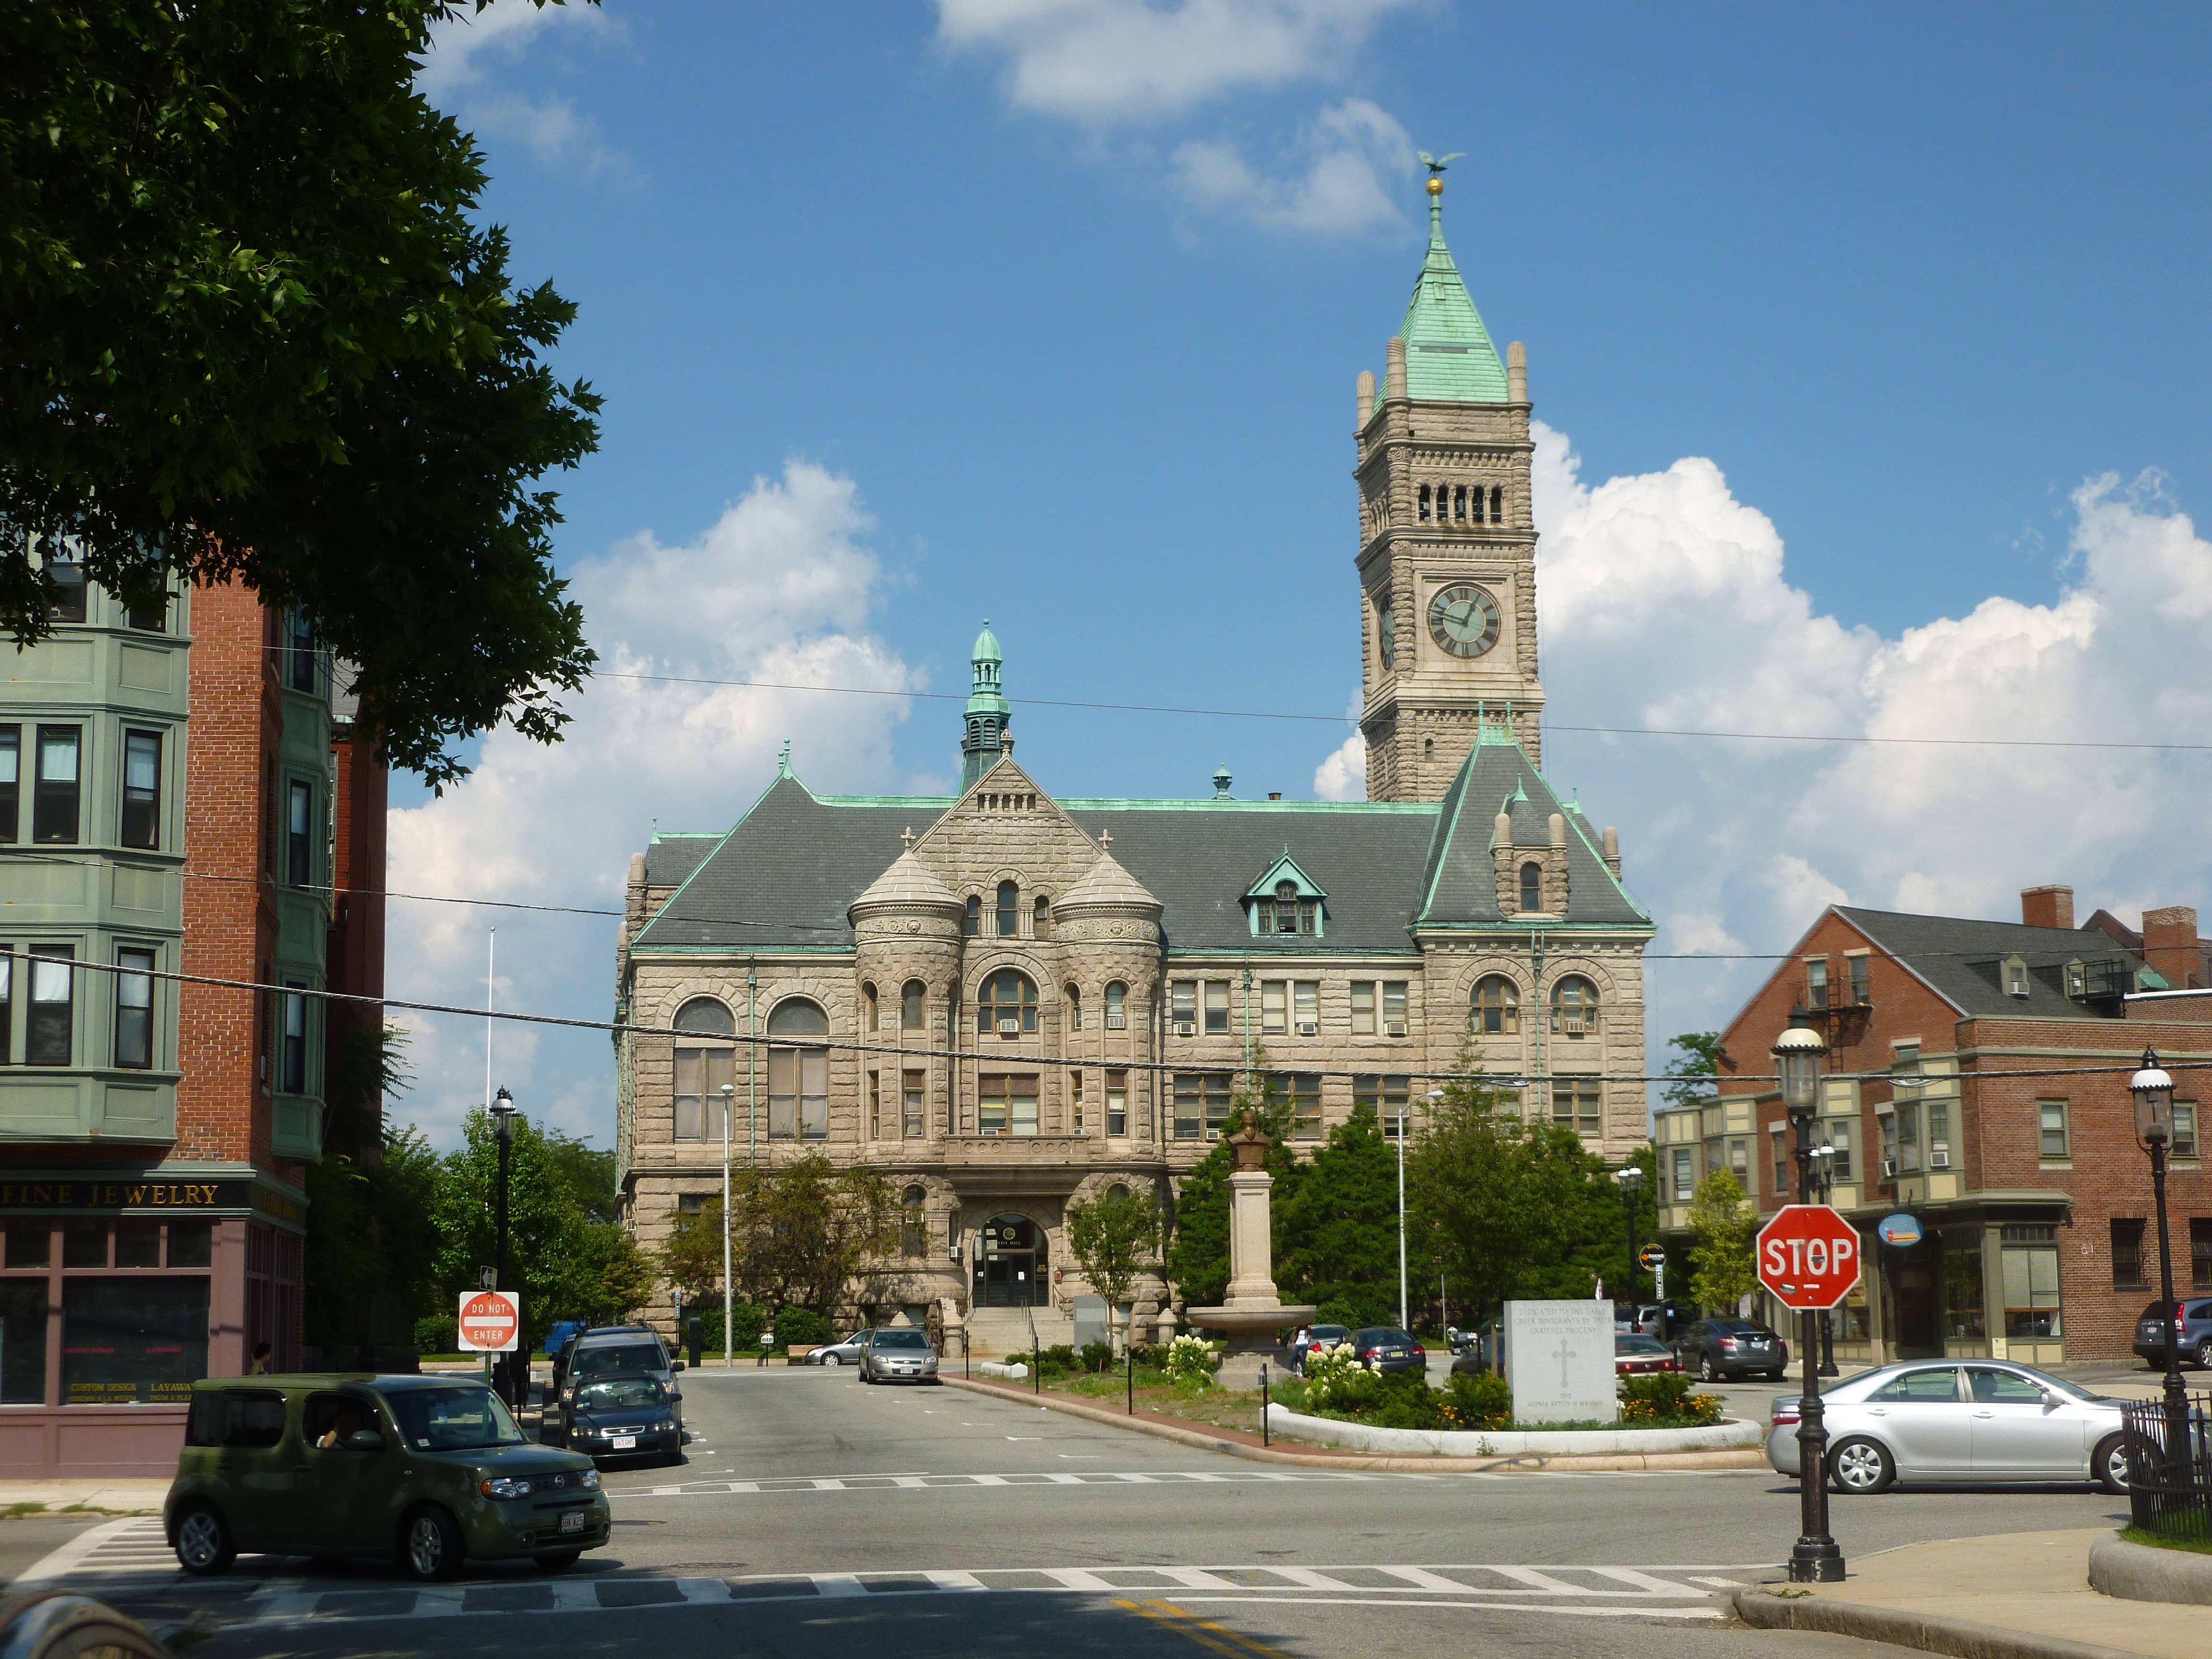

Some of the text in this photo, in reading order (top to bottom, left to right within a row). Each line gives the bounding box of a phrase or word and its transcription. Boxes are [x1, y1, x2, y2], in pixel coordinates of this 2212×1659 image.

[1, 1185, 219, 1207] FINE JEWELRY
[1765, 1238, 1853, 1276] STOP
[472, 1304, 506, 1313] DO NOT
[474, 1330, 503, 1339] ENTER
[108, 1383, 137, 1391] DESIGN
